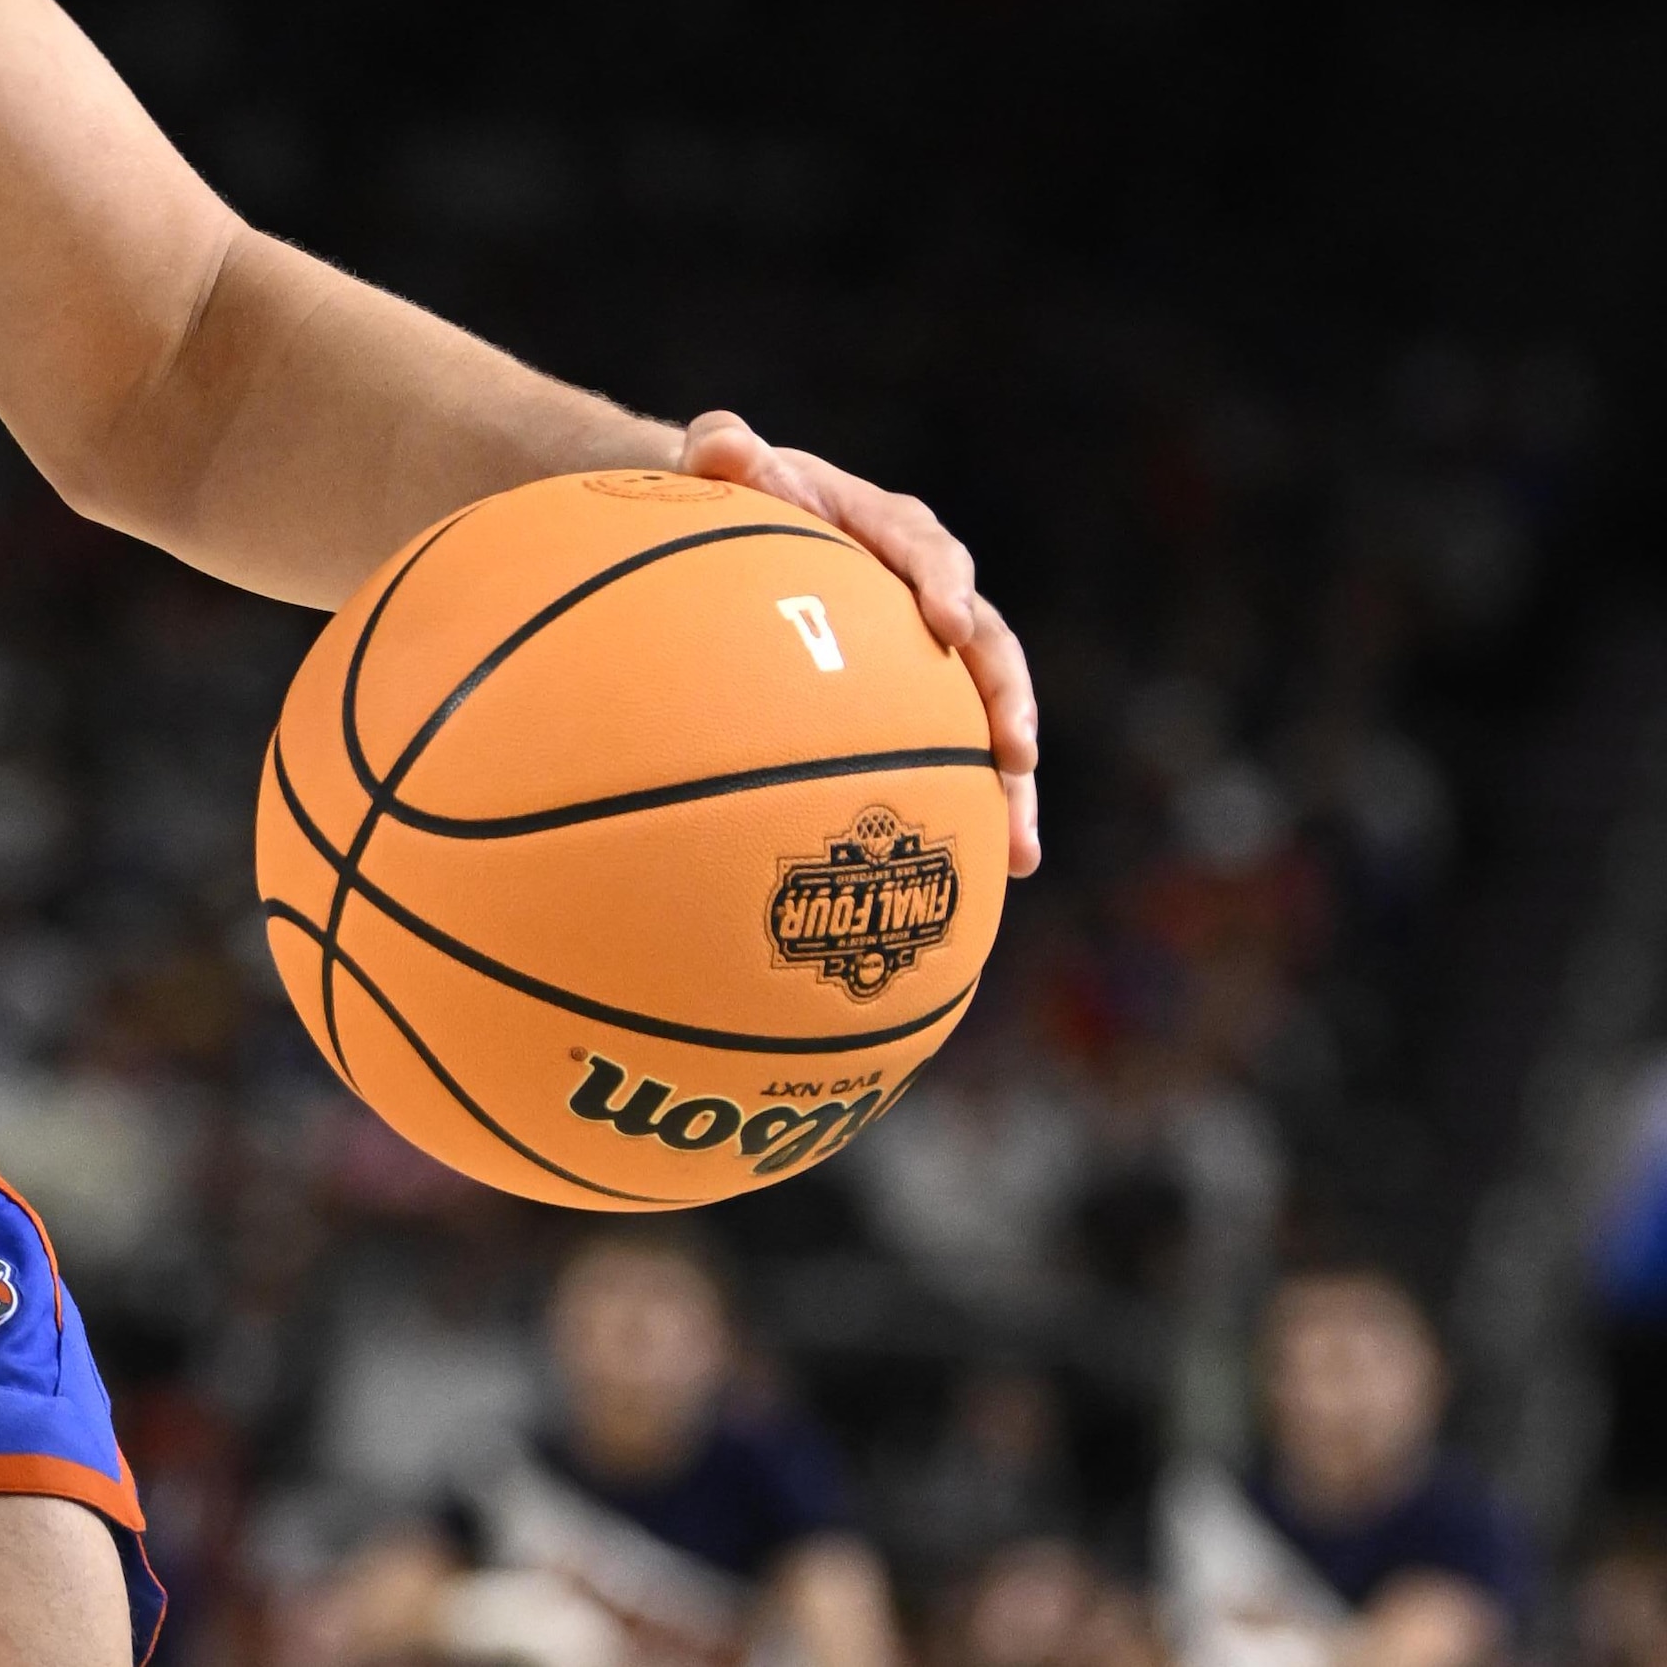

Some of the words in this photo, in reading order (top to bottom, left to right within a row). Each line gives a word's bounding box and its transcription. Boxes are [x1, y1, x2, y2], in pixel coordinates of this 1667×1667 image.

[778, 893, 874, 939] FOUR
[878, 878, 952, 932] FINAL
[760, 1080, 824, 1098] NXT
